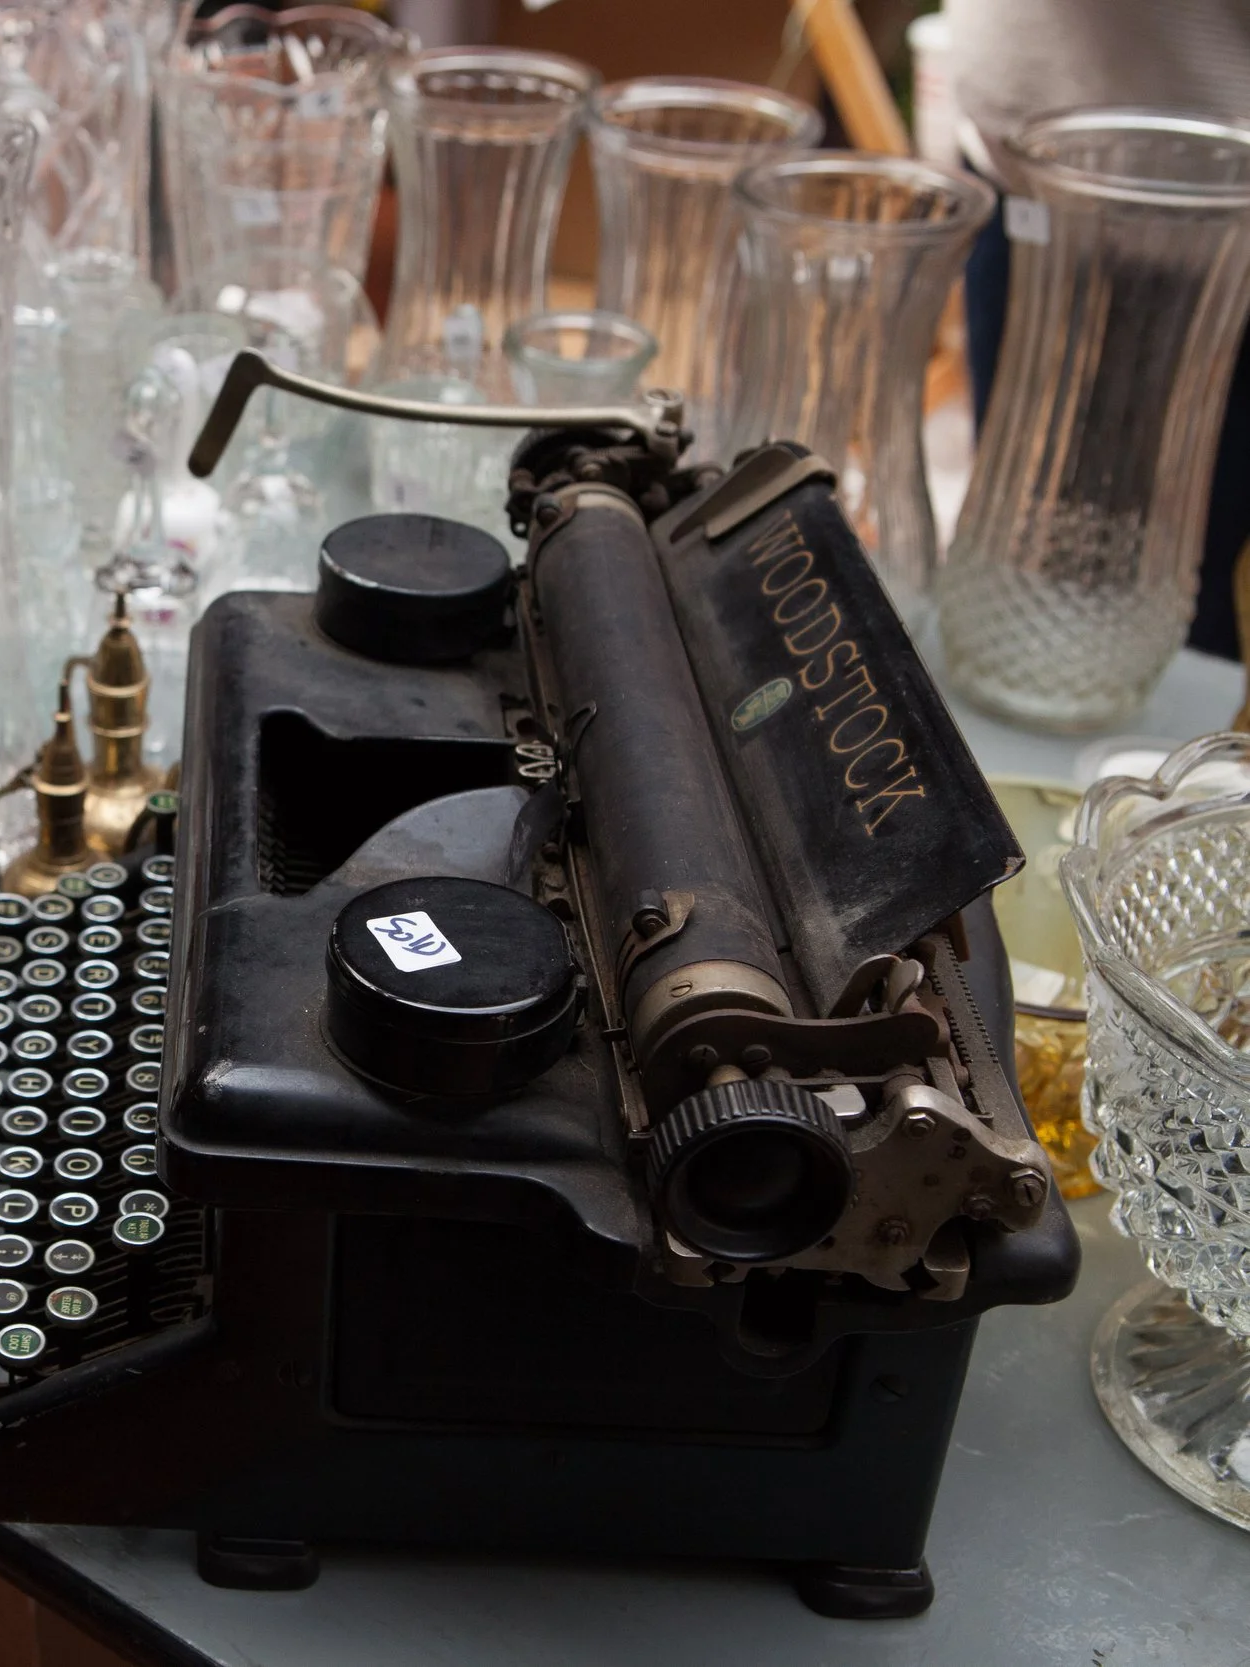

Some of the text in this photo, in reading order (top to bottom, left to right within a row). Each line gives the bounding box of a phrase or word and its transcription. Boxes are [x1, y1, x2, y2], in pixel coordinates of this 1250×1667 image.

[750, 510, 925, 836] WOODSTOCK
[8, 1334, 20, 1351] LOCK
[20, 1334, 32, 1353] SHIFT
